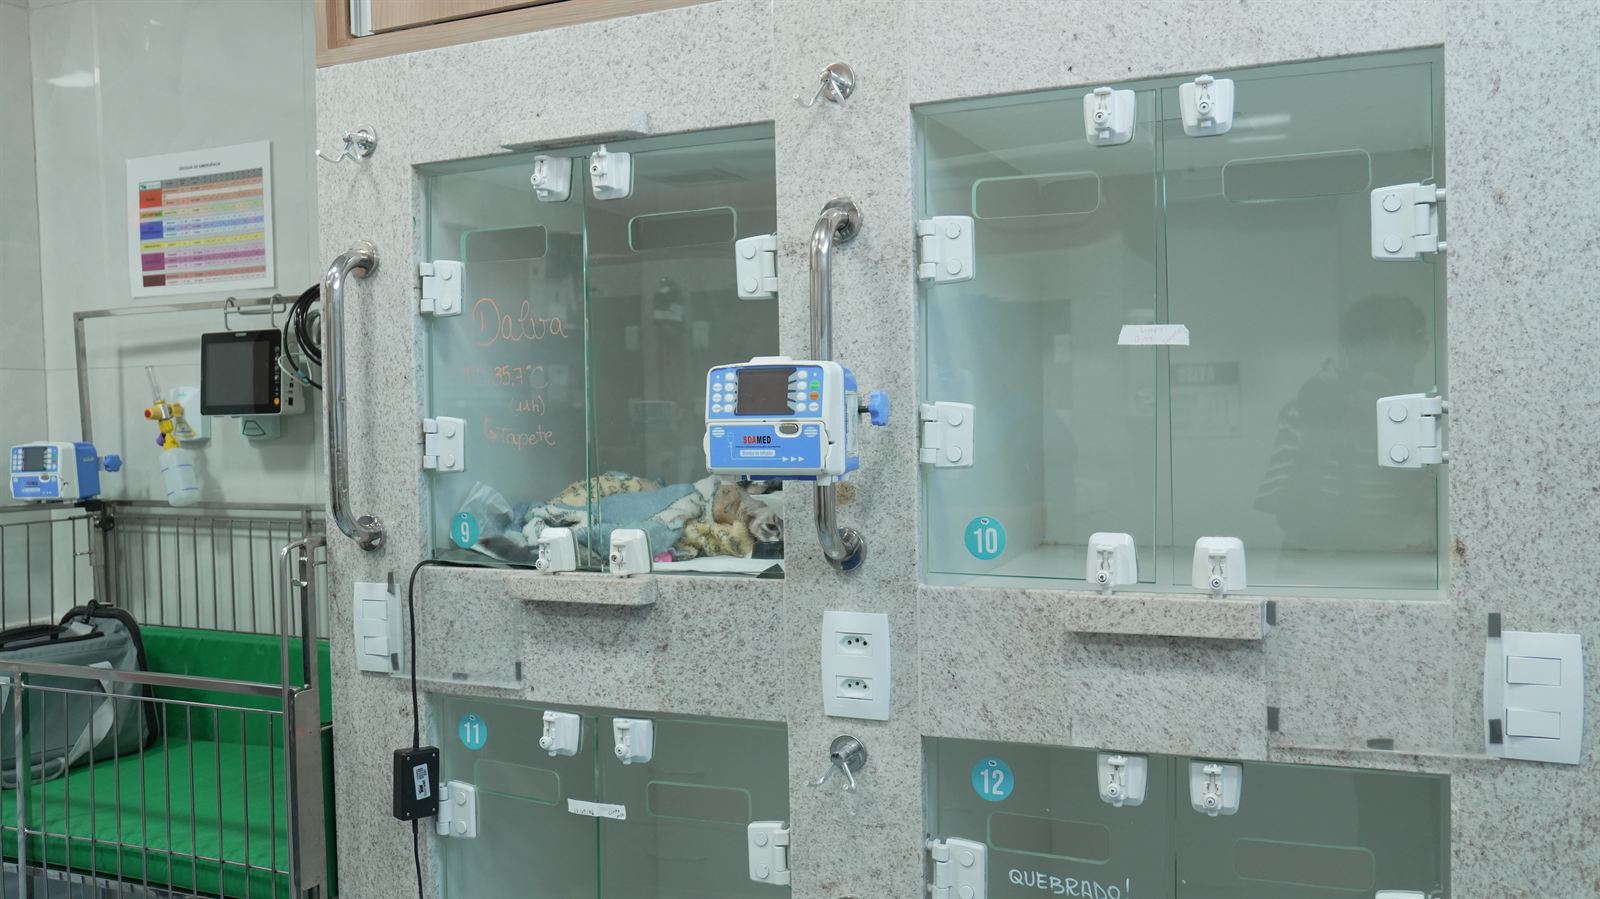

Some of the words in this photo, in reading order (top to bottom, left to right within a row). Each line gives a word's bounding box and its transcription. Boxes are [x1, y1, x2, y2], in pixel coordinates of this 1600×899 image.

[472, 297, 568, 346] Dalva
[743, 435, 772, 444] SDAMED
[461, 521, 470, 543] 9
[973, 527, 998, 554] 10
[463, 721, 480, 745] 11
[980, 768, 1004, 796] 12
